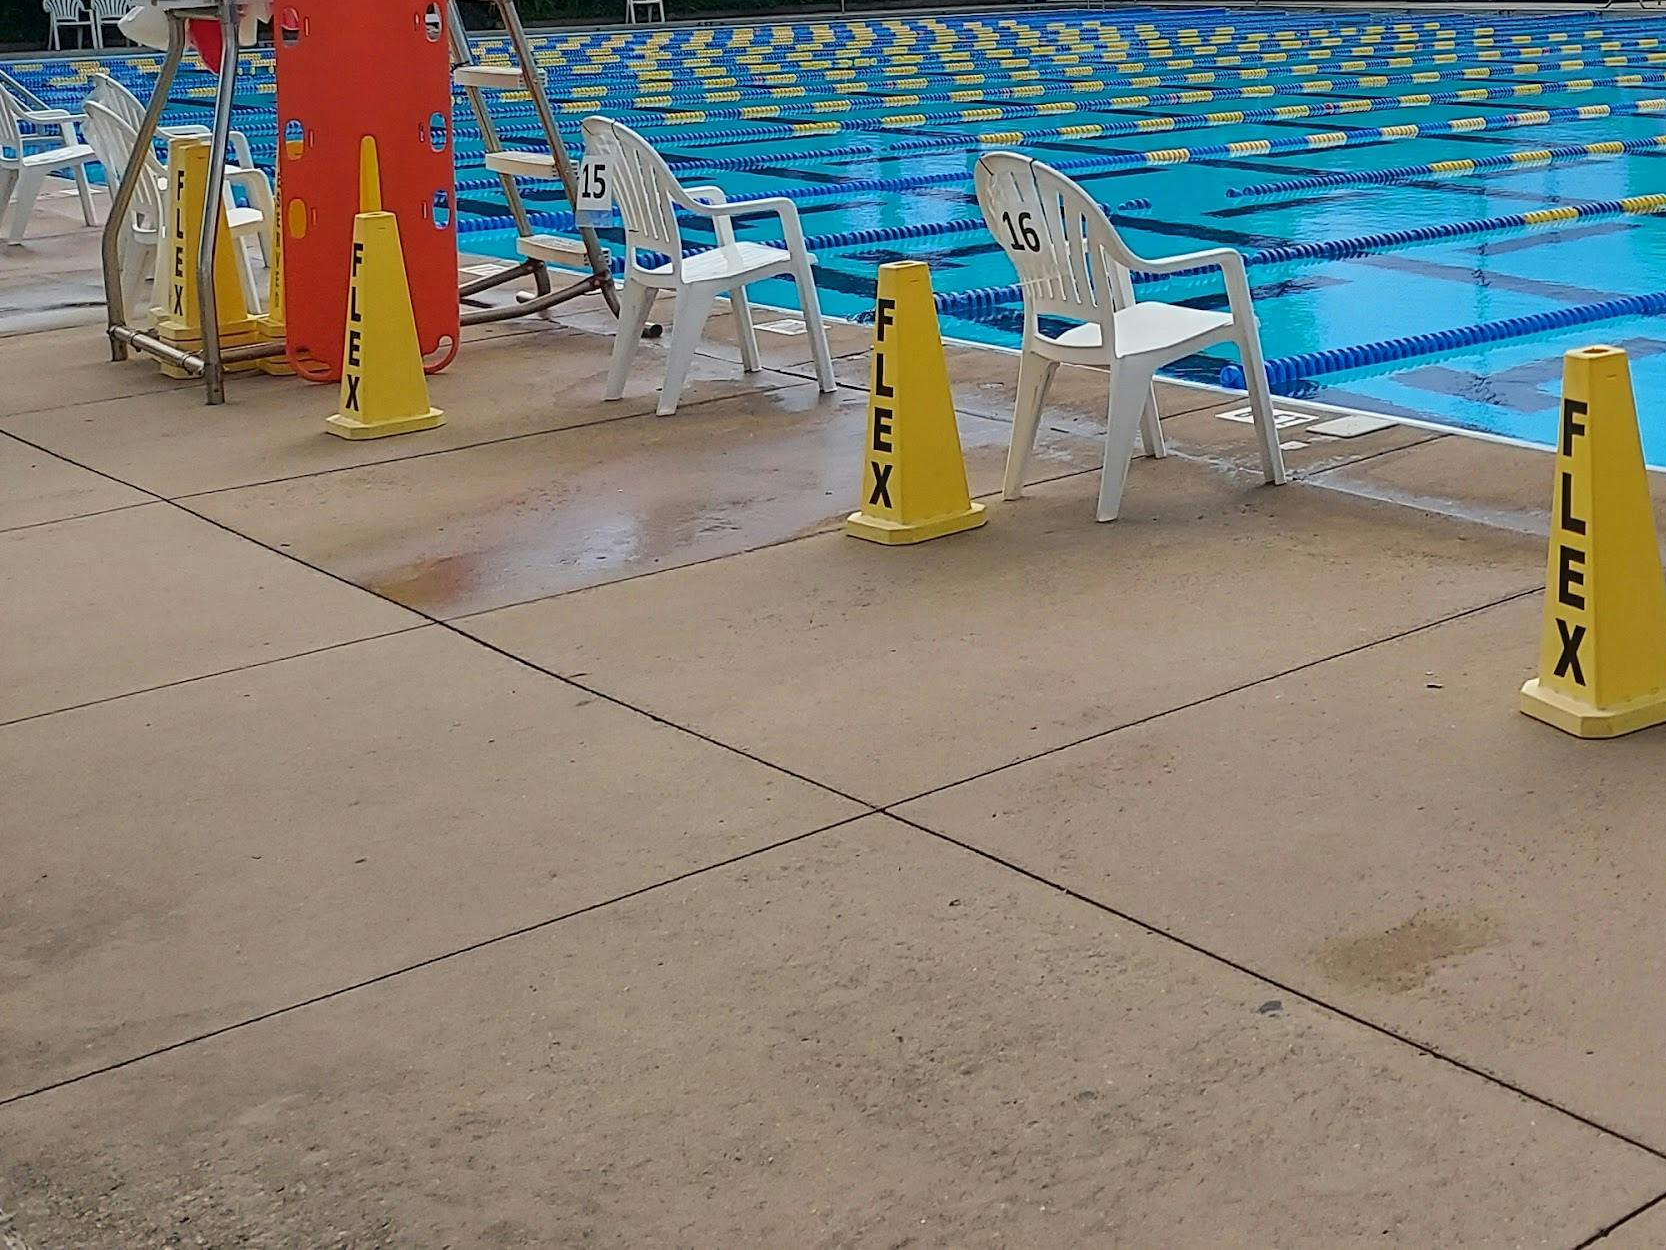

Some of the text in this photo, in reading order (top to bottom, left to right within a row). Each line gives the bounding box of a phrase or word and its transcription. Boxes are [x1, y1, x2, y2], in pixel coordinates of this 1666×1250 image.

[174, 170, 185, 317] FLEX
[582, 163, 606, 199] 15
[1002, 211, 1041, 253] 16
[345, 242, 364, 412] FLEX
[868, 298, 896, 510] FLEX
[1553, 398, 1588, 687] FLEX
